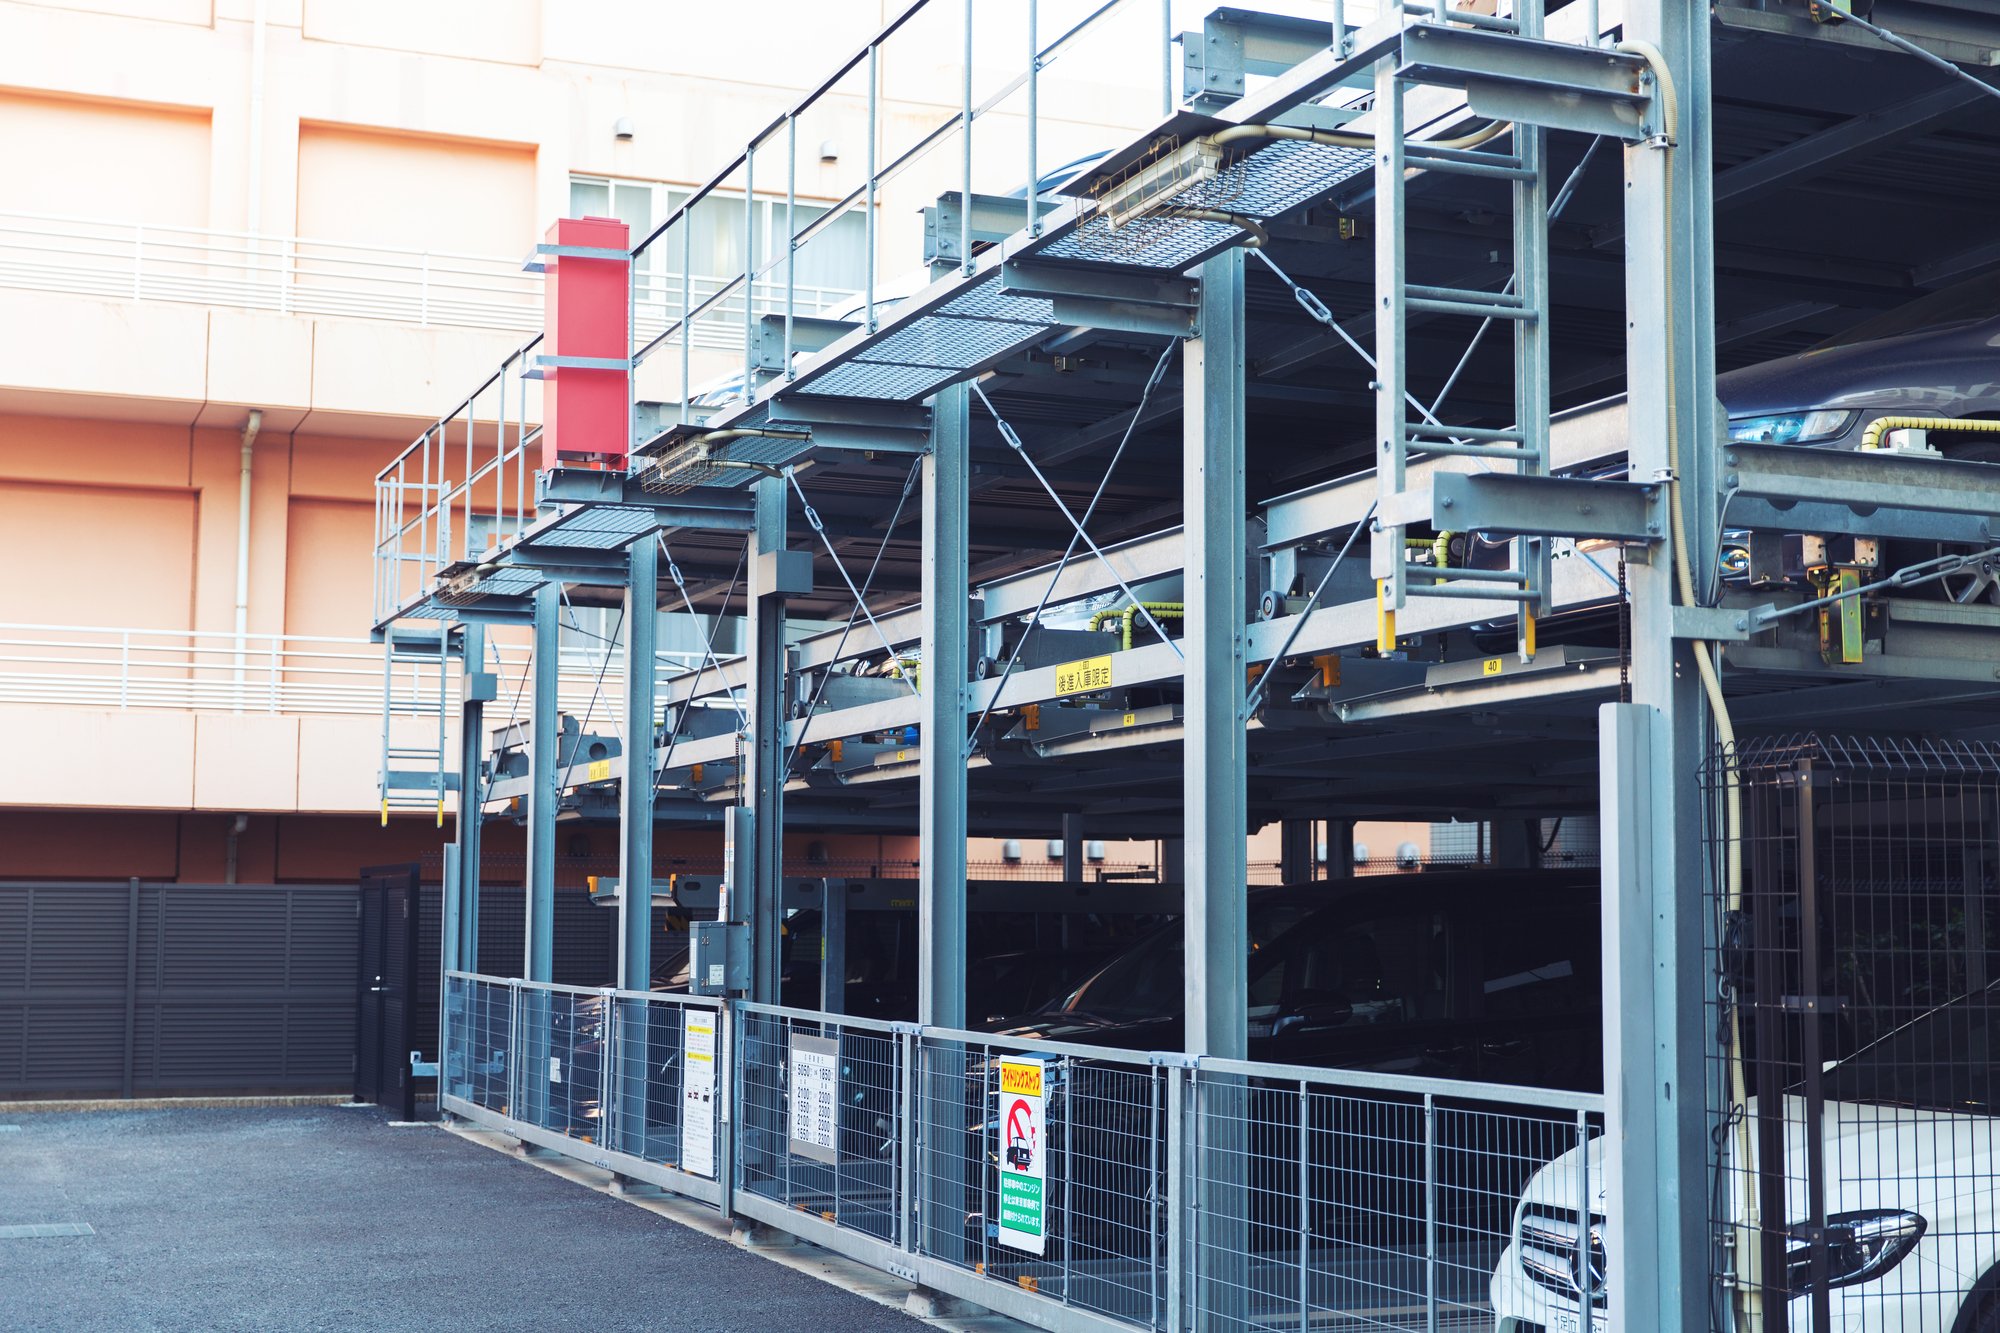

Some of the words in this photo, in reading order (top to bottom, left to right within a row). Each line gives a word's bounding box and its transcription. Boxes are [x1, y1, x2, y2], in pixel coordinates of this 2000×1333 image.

[1488, 660, 1497, 672] 40
[1058, 667, 1109, 692] 後進入庫限定
[797, 1064, 810, 1077] 5050
[819, 1068, 831, 1081] 1850
[1002, 1068, 1041, 1090] アイドリングストップ
[797, 1086, 810, 1100] 2100
[818, 1091, 831, 1105] 2300
[797, 1100, 810, 1114] 1550
[818, 1104, 831, 1119] 2300
[797, 1113, 810, 1127] 2100
[817, 1118, 831, 1133] 2300
[797, 1127, 809, 1141] 1550
[817, 1132, 830, 1147] 2300
